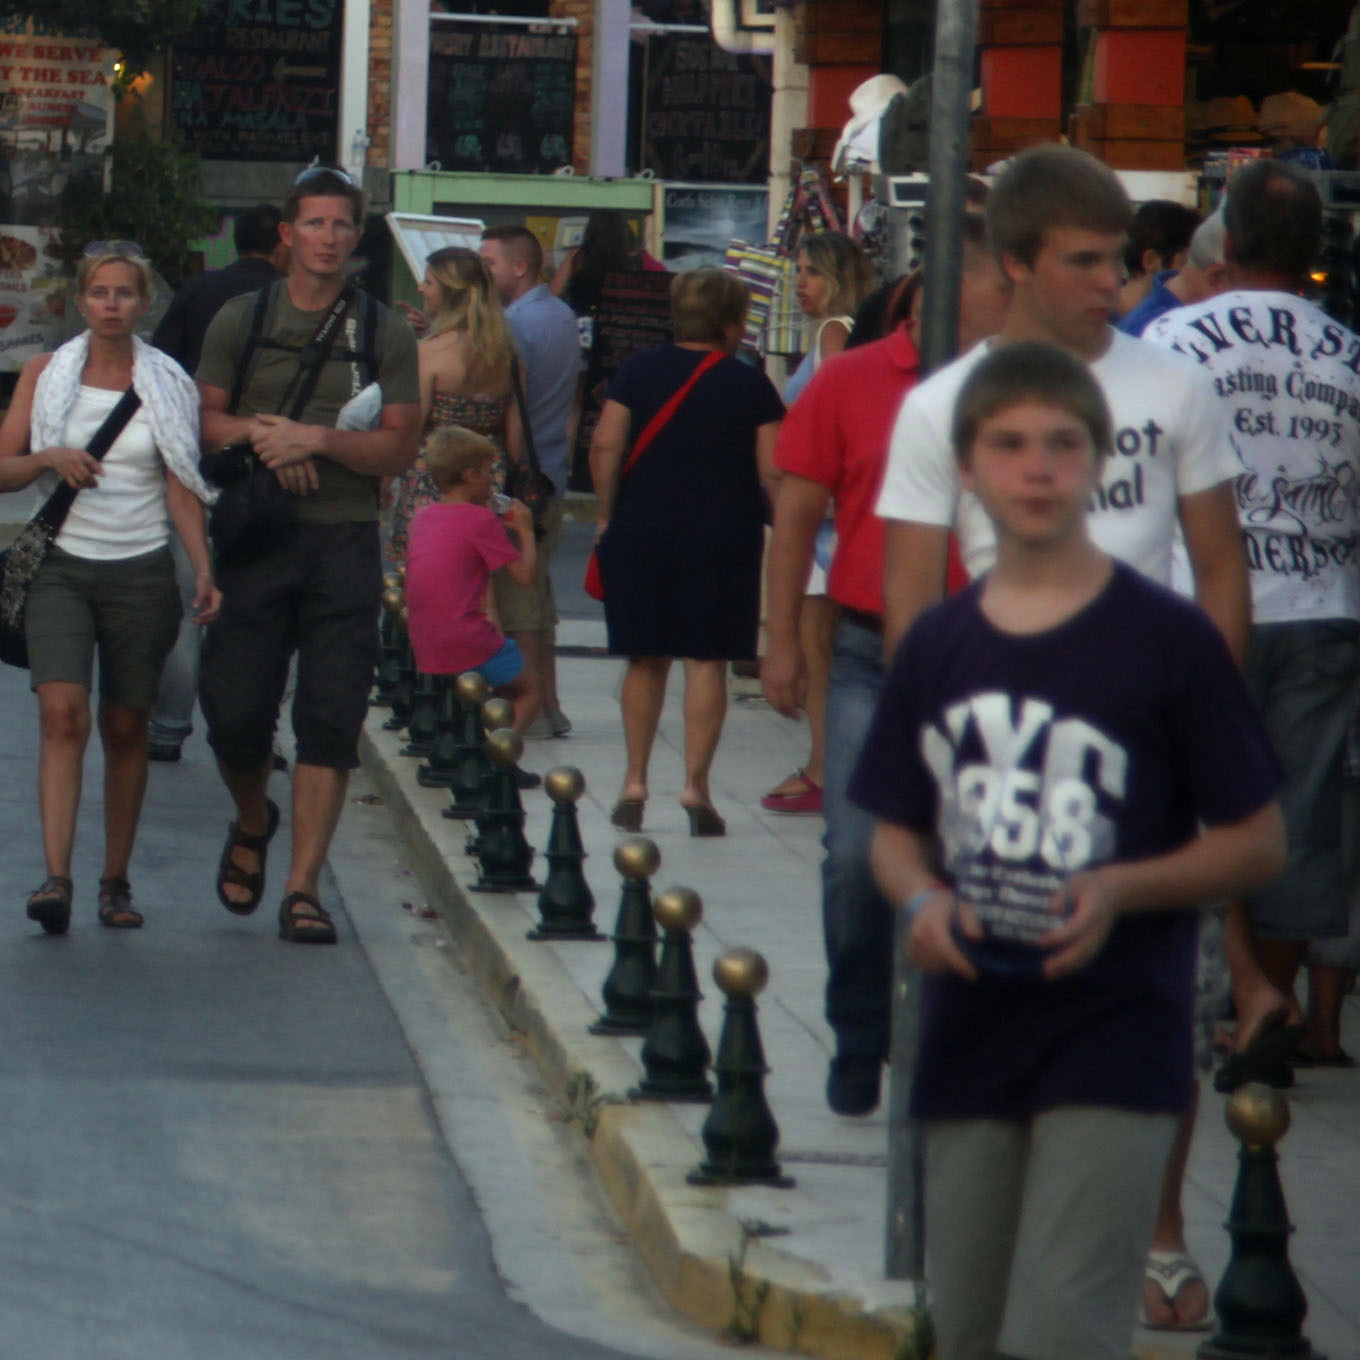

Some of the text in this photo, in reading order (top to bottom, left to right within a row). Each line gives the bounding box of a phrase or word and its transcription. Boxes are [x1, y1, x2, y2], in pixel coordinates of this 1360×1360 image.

[33, 45, 103, 63] SERVE
[20, 66, 62, 84] THE
[67, 69, 108, 86] SEA
[1116, 418, 1164, 458] ot
